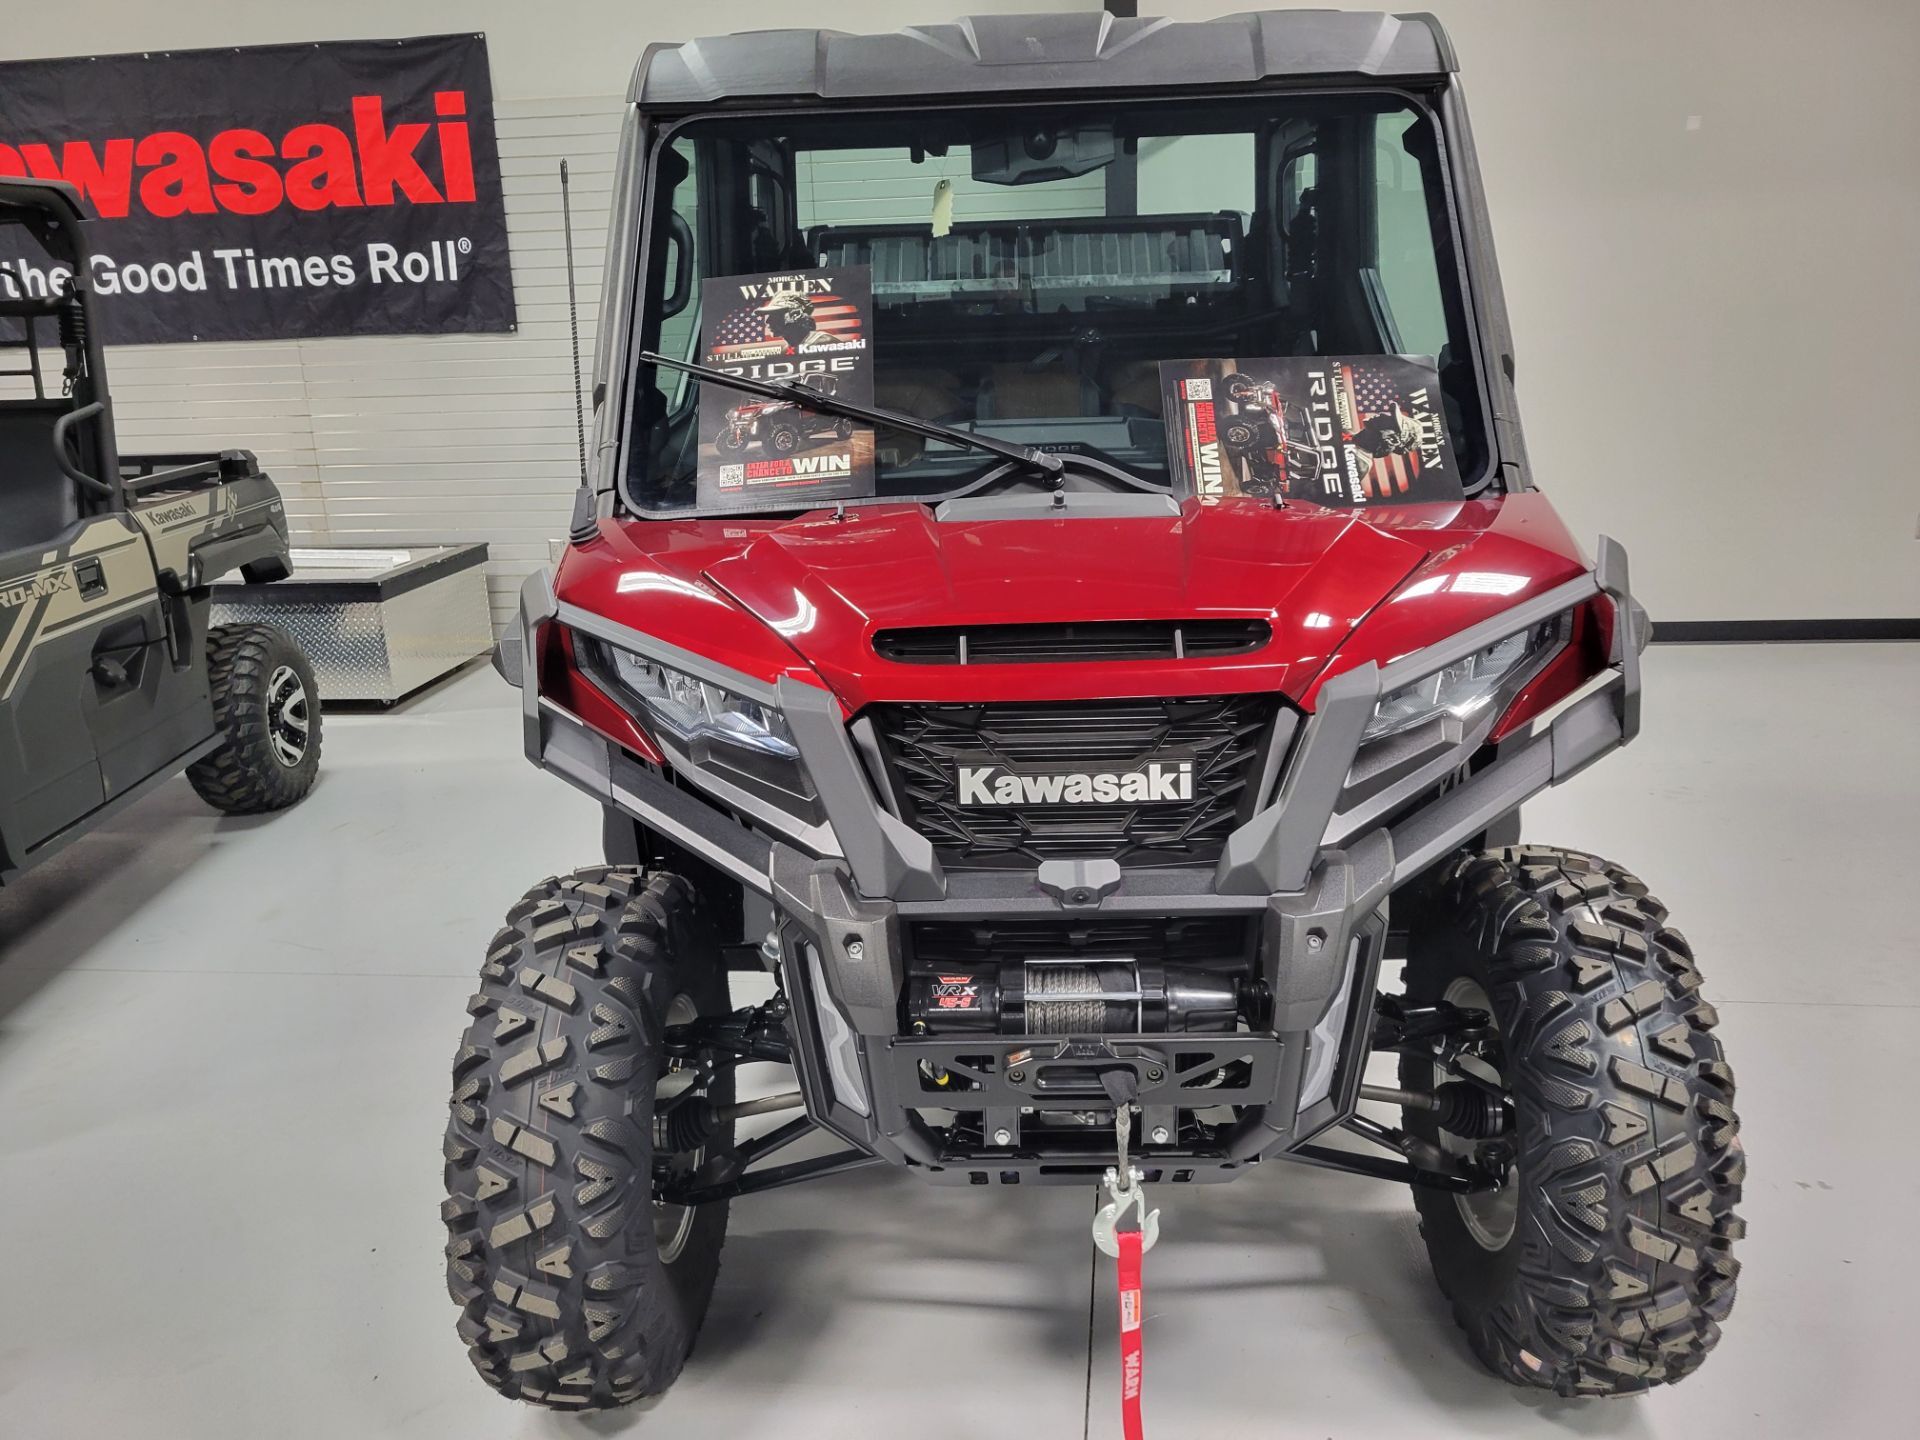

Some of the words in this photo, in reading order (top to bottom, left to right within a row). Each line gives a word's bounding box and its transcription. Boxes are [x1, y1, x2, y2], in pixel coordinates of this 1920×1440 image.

[0, 91, 477, 218] wasaki
[90, 251, 207, 295] Good
[213, 248, 356, 290] Times
[739, 277, 834, 301] WALLEN
[767, 274, 806, 284] MORGAN
[798, 338, 867, 354] Kawasaki
[1308, 371, 1343, 494] RIDGE
[792, 454, 851, 474] WIN
[1200, 442, 1224, 494] WIN
[1343, 444, 1367, 503] Kawasaki
[146, 501, 197, 527] Kawasaki
[958, 762, 1193, 806] Kawasaki
